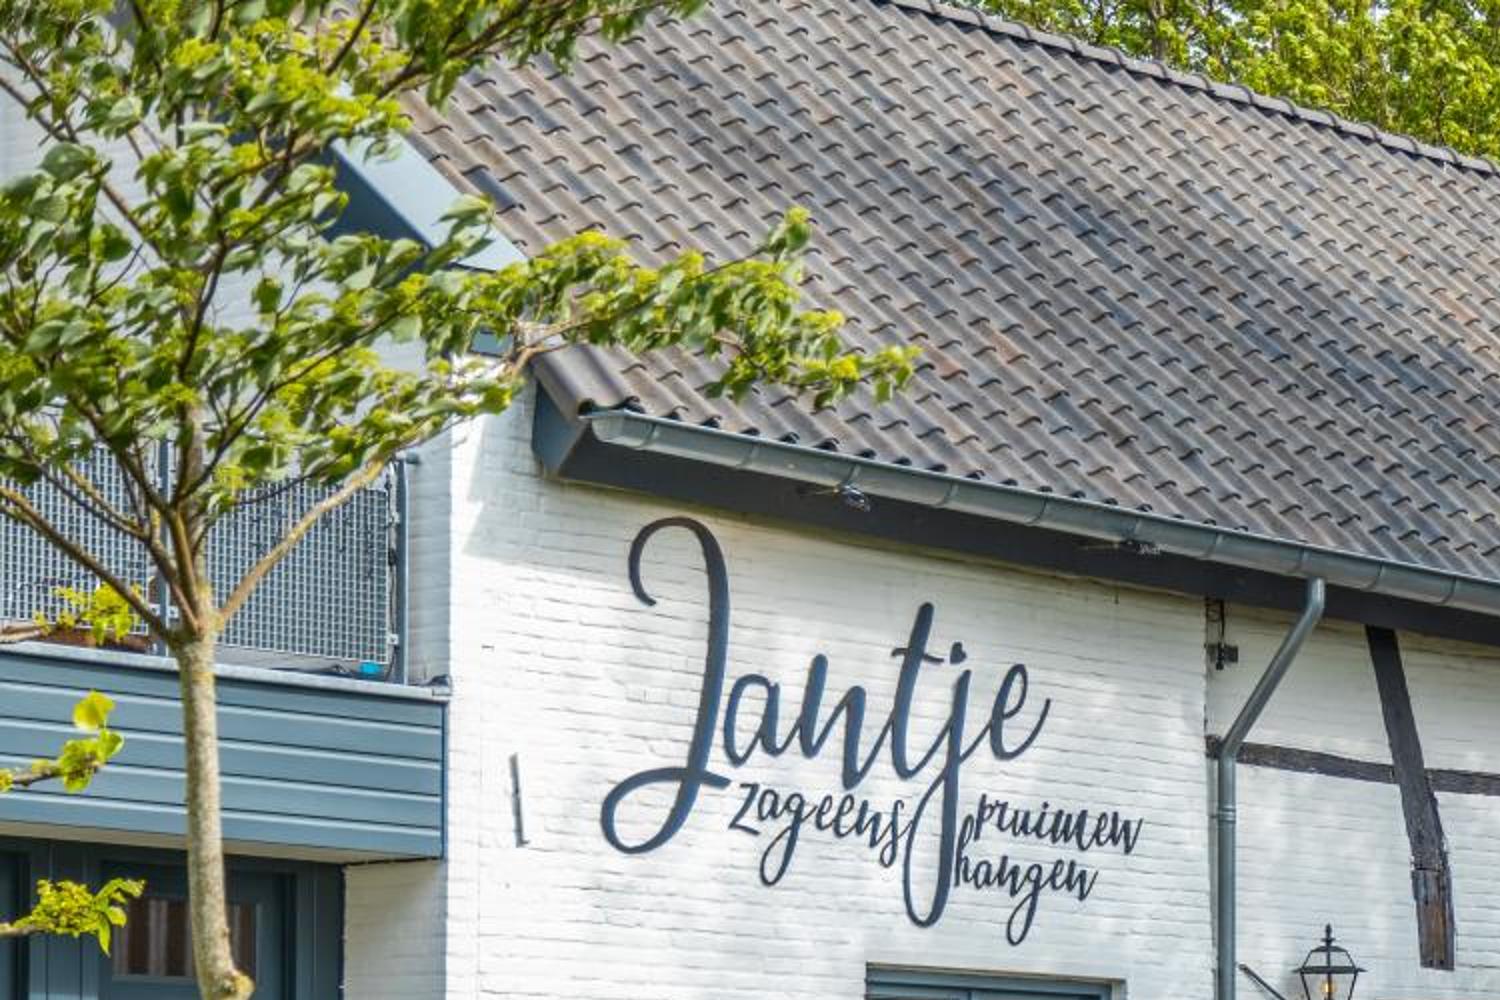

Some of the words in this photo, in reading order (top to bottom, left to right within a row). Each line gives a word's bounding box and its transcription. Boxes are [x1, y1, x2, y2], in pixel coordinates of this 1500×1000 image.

[600, 516, 1051, 929] Jantje
[954, 814, 1099, 946] hangen
[974, 793, 1143, 855] pruimen
